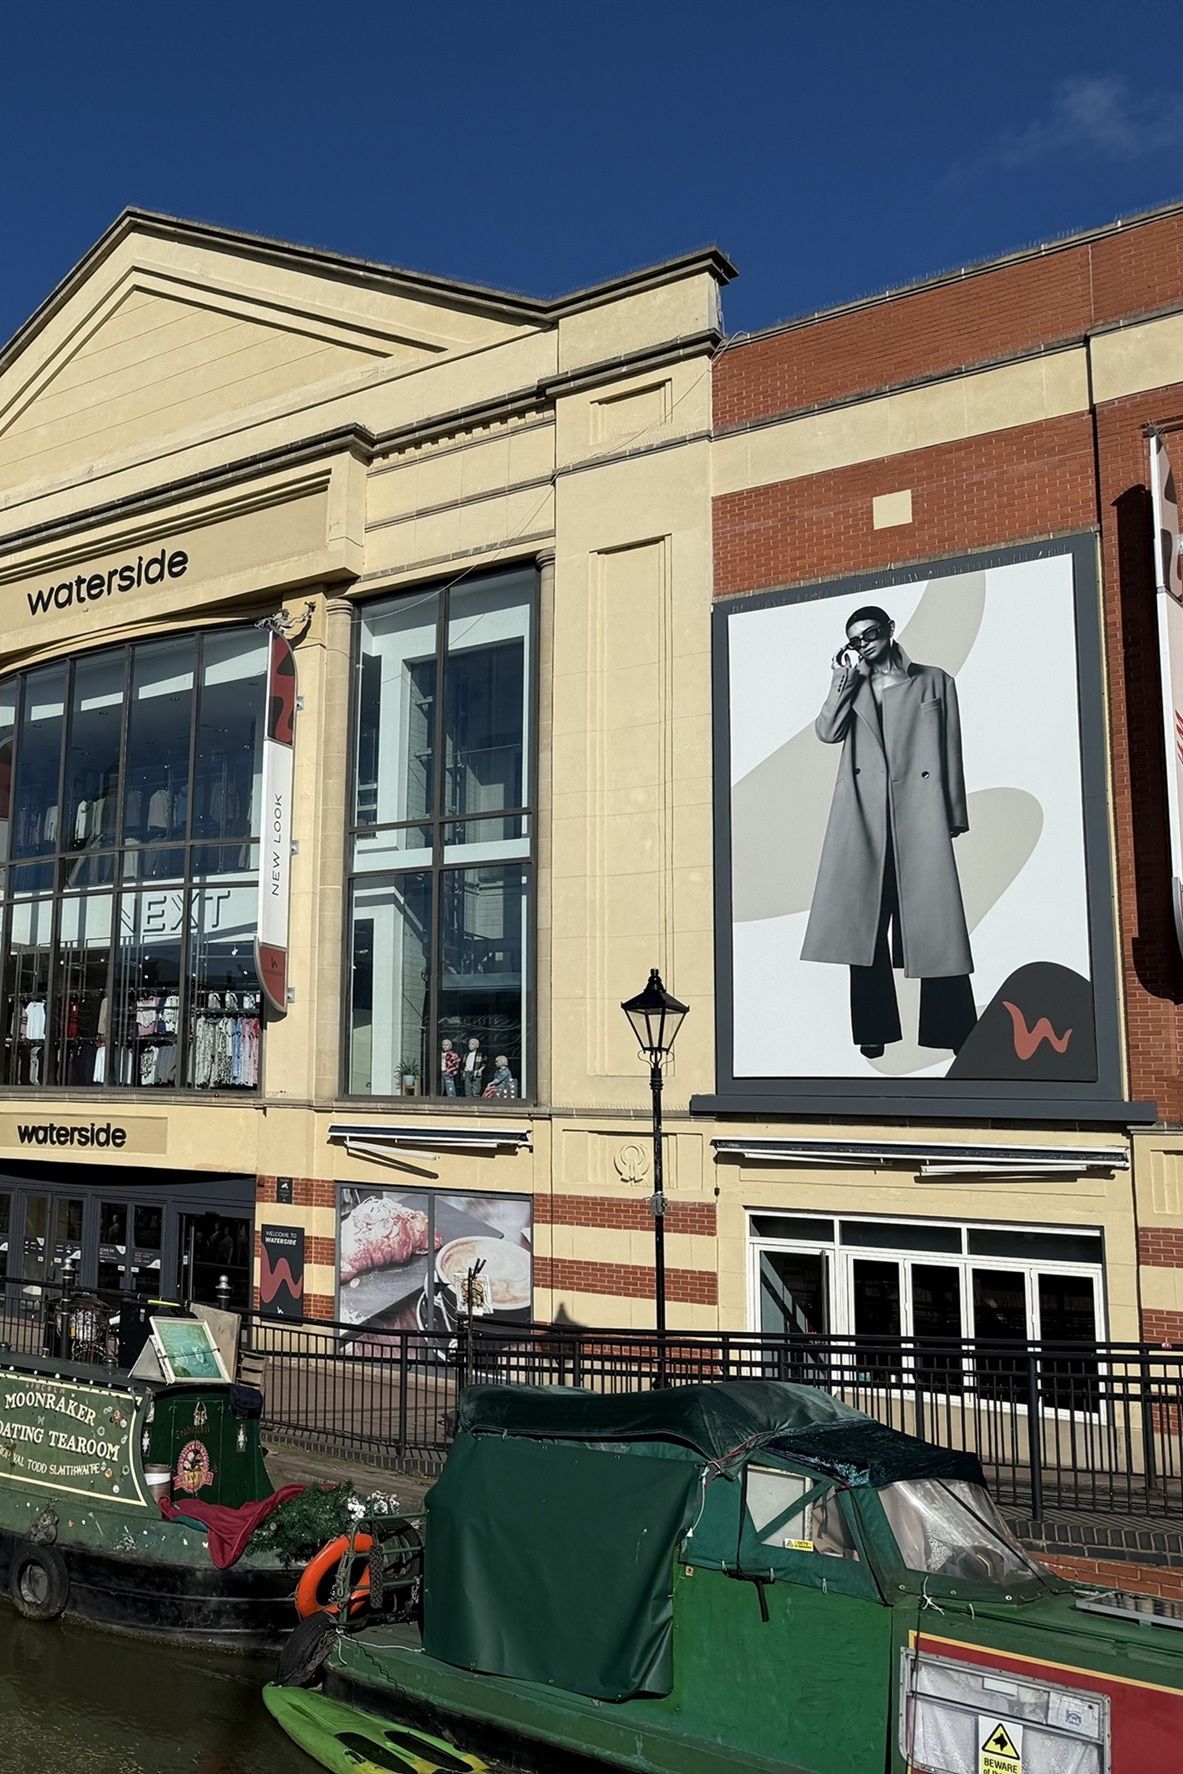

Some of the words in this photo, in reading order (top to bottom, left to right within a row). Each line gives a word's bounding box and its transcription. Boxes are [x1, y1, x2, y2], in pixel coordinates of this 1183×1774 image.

[27, 548, 189, 616] waterside
[274, 793, 283, 844] LOOK
[272, 852, 281, 897] NEW
[17, 1122, 127, 1148] waterside
[265, 1236, 296, 1246] WATERSIDE
[266, 1230, 289, 1238] WELCOME
[5, 1391, 96, 1426] MOONRAKER
[49, 1430, 120, 1462] TEAROOM
[13, 1454, 24, 1467] VAL
[27, 1459, 48, 1474] TODD
[984, 1757, 1018, 1773] BEWARE
